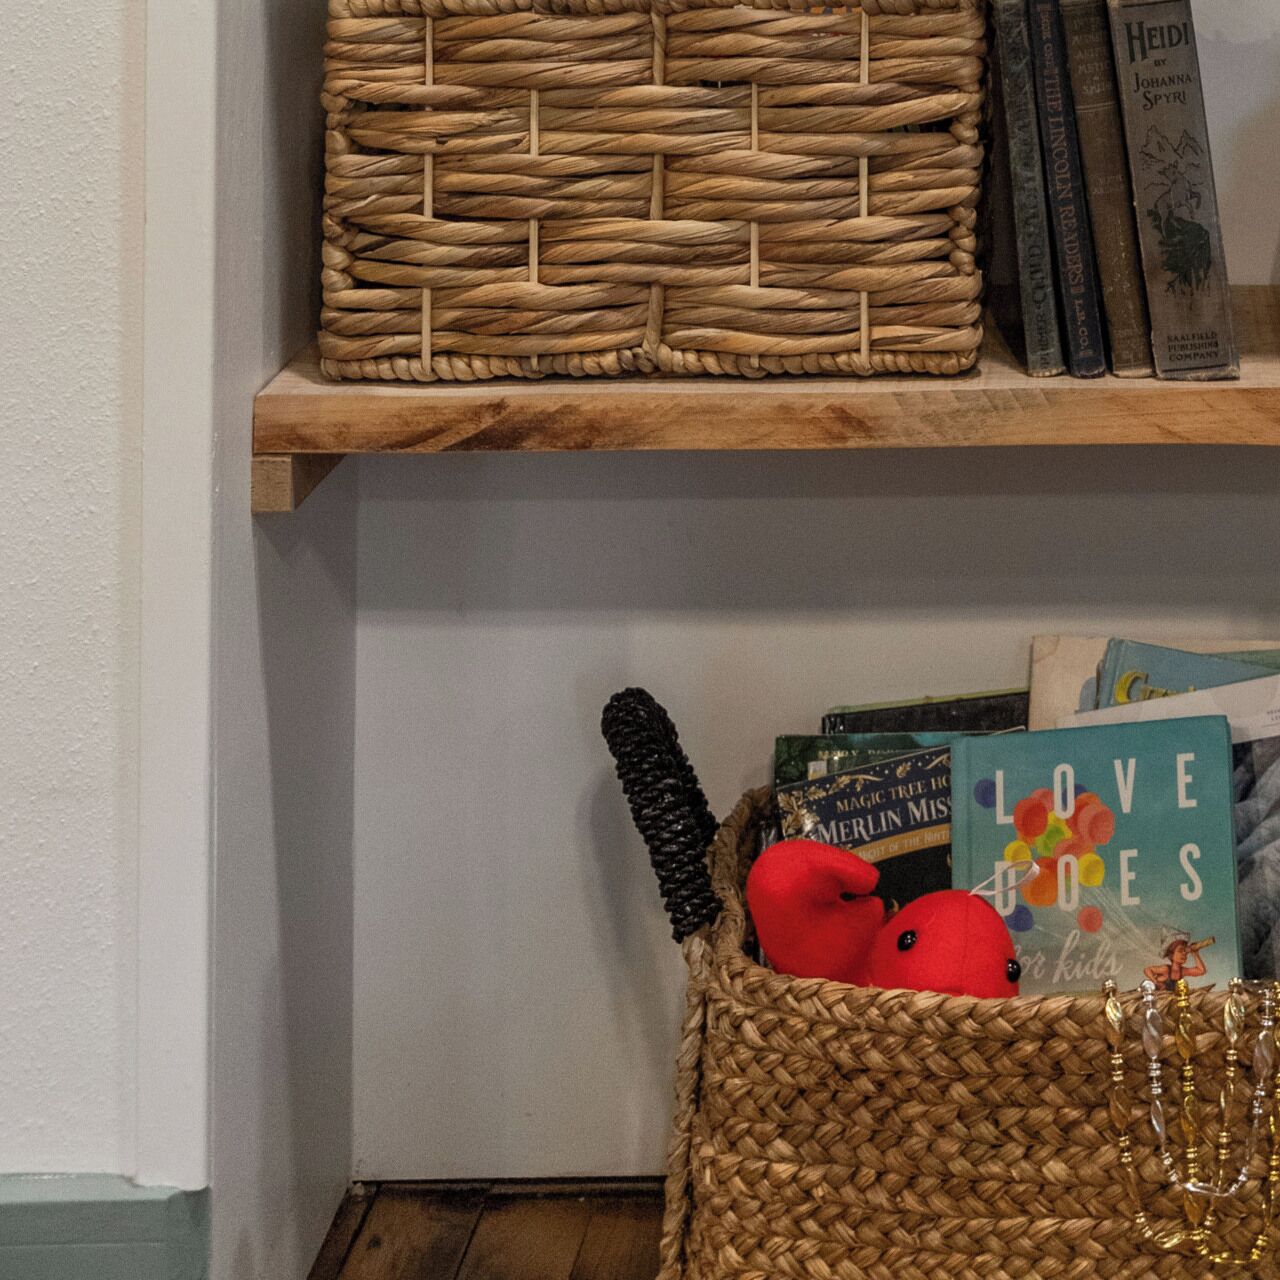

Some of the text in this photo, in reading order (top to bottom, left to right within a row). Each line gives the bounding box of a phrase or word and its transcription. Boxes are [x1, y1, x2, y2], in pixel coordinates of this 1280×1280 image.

[1124, 21, 1189, 64] HEIDI
[1133, 72, 1192, 93] JOHANNA
[1154, 59, 1167, 67] BY
[1143, 90, 1187, 111] SPYRI
[1048, 116, 1073, 200] LINCOLN
[1060, 205, 1084, 284] READERS
[1169, 350, 1219, 361] COMPANY
[837, 792, 887, 814] MAGIC
[891, 780, 927, 799] TREE
[995, 752, 1198, 825] LOVE
[816, 808, 902, 845] MERLIN
[994, 843, 1203, 917] DOES
[1052, 929, 1124, 985] kids
